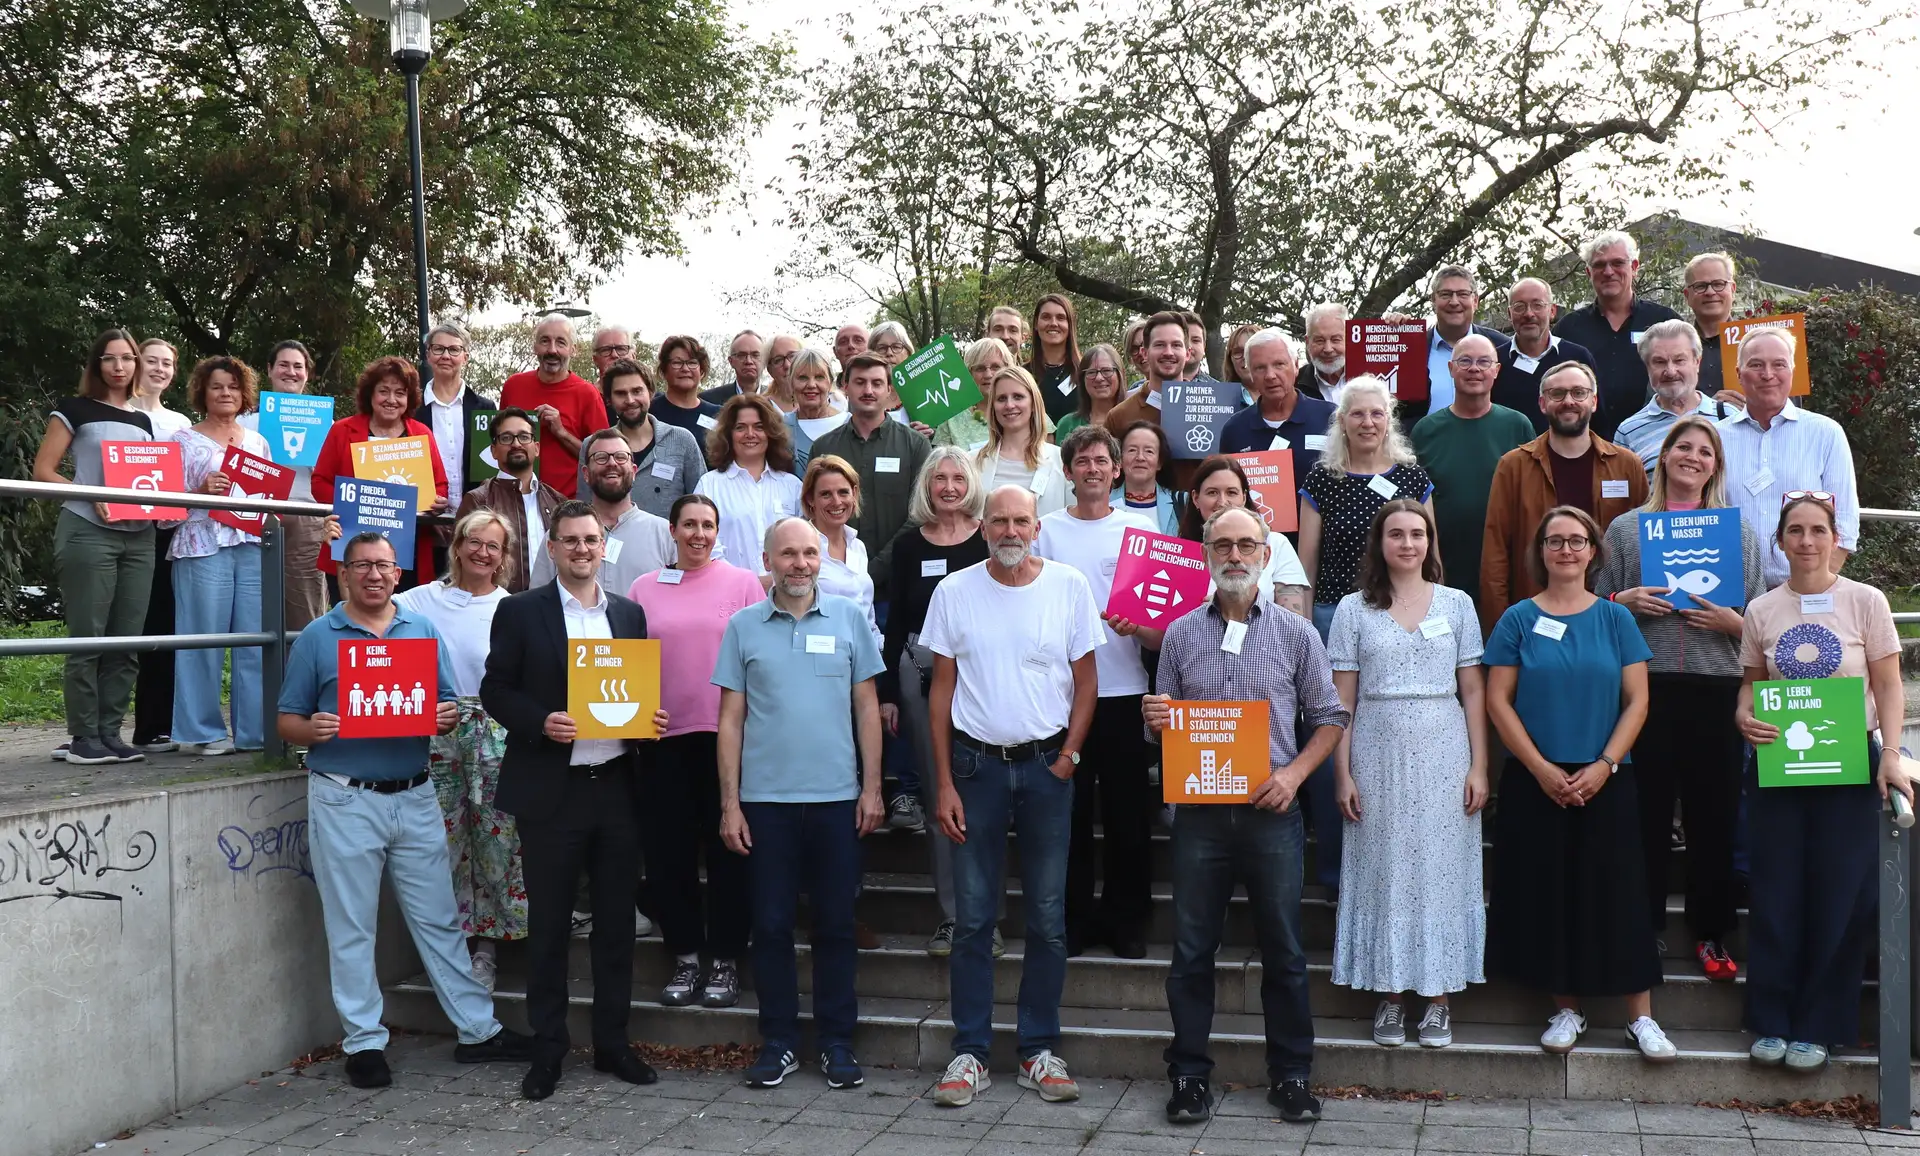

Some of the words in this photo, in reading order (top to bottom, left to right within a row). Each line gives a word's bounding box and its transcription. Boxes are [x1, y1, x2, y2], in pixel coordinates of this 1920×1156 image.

[1351, 325, 1361, 343] 8
[1365, 334, 1386, 343] ARBEIT
[1386, 334, 1399, 343] UND
[1724, 326, 1740, 345] 12
[1365, 344, 1409, 353] WIRTSCHAFTS-
[904, 348, 935, 372] GESUNDHEIT
[932, 342, 946, 354] UND
[1365, 354, 1399, 363] WACHSTUM
[907, 353, 945, 380] WOHLERGEHEN
[894, 370, 906, 387] 3
[1167, 385, 1182, 404] 17
[1185, 386, 1215, 395] PARTNER-
[266, 396, 275, 413] 6
[309, 400, 332, 409] WASSER
[1185, 395, 1216, 404] SCHAFTEN
[1185, 404, 1197, 413] ZUR
[1197, 405, 1234, 414] ERREICHUNG
[474, 414, 488, 431] 13
[1184, 414, 1196, 422] DER
[1197, 414, 1213, 423] ZIELE
[124, 446, 170, 455] GESCHLECHTER-
[372, 441, 409, 454] BEZAHLBARE
[409, 440, 422, 449] UND
[108, 445, 119, 464] 5
[125, 455, 158, 464] GLEICHHEIT
[358, 446, 366, 464] 7
[373, 451, 401, 462] SAUBERE
[400, 450, 424, 460] ENERGIE
[228, 453, 240, 470] 4
[243, 456, 281, 478] HOCHWERTIGE
[241, 465, 265, 481] BILDUNG
[1265, 465, 1279, 474] UND
[339, 482, 357, 503] 16
[360, 484, 387, 497] FRIEDEN,
[360, 495, 407, 509] GERECHTIGKEIT
[359, 505, 372, 515] UND
[372, 507, 396, 518] STARKE
[357, 515, 404, 529] INSTITUTIONEN
[1670, 516, 1694, 528] LEBEN
[1694, 515, 1719, 526] UNTER
[1644, 518, 1665, 541] 14
[1671, 527, 1703, 539] WASSER
[1127, 534, 1147, 557] 10
[1151, 538, 1183, 555] WENIGER
[1149, 549, 1206, 571] UNGLEICHHEITEN
[365, 645, 388, 655] KEINE
[576, 644, 587, 668] 2
[594, 644, 611, 655] KEIN
[348, 645, 356, 668] 1
[365, 657, 393, 668] ARMUT
[594, 657, 623, 668] HUNGER
[1786, 686, 1812, 697] LEBEN
[1759, 687, 1782, 711] 15
[1787, 699, 1799, 710] AN
[1799, 698, 1822, 709] LAND
[1169, 707, 1184, 731] 11
[1189, 707, 1243, 718] NACHHALTIGE
[1189, 719, 1219, 731] STÄDTE
[1219, 720, 1237, 731] UND
[1189, 732, 1235, 743] GEMEINDEN
